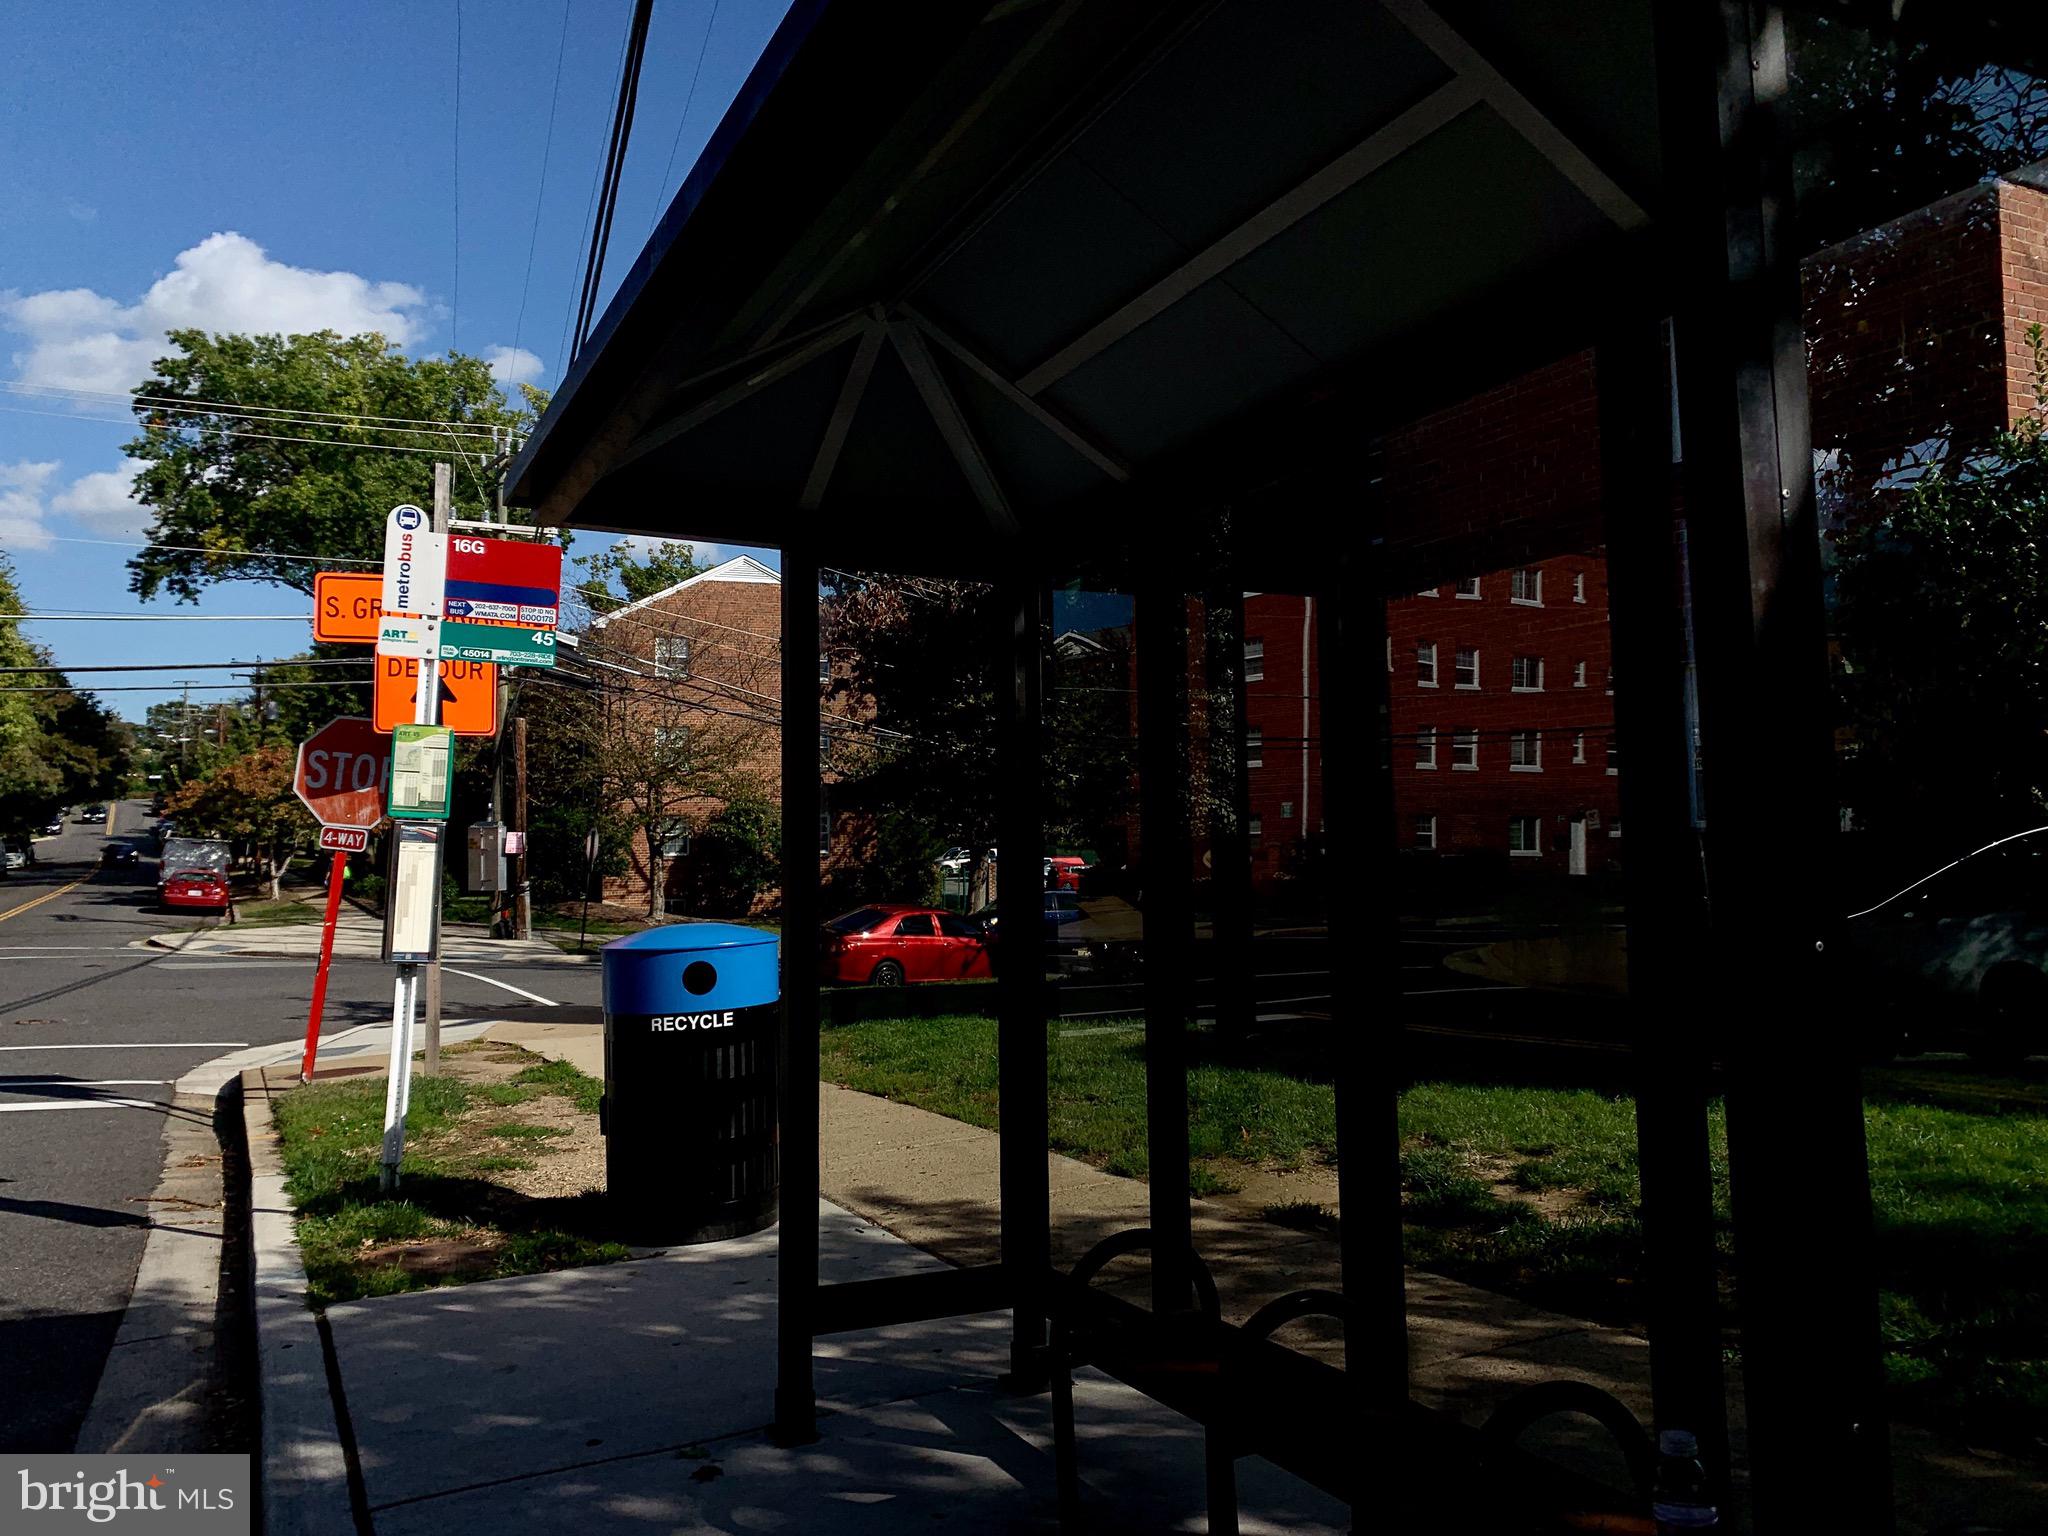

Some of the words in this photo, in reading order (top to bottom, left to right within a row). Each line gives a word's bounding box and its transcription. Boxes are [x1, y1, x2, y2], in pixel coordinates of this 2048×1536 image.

[452, 538, 485, 555] 16G
[397, 533, 413, 609] metrobus
[325, 596, 346, 619] S.
[448, 600, 467, 608] NEXT
[474, 610, 517, 620] WMATA.COM
[520, 614, 555, 623] 6000178
[382, 629, 408, 639] ART
[532, 631, 555, 646] 45
[463, 650, 491, 659] 45014
[496, 656, 553, 665] arlingtontransit.com
[388, 658, 483, 680] DEOUR
[324, 832, 363, 847] 4-WAY
[651, 1011, 734, 1032] RECYCLE
